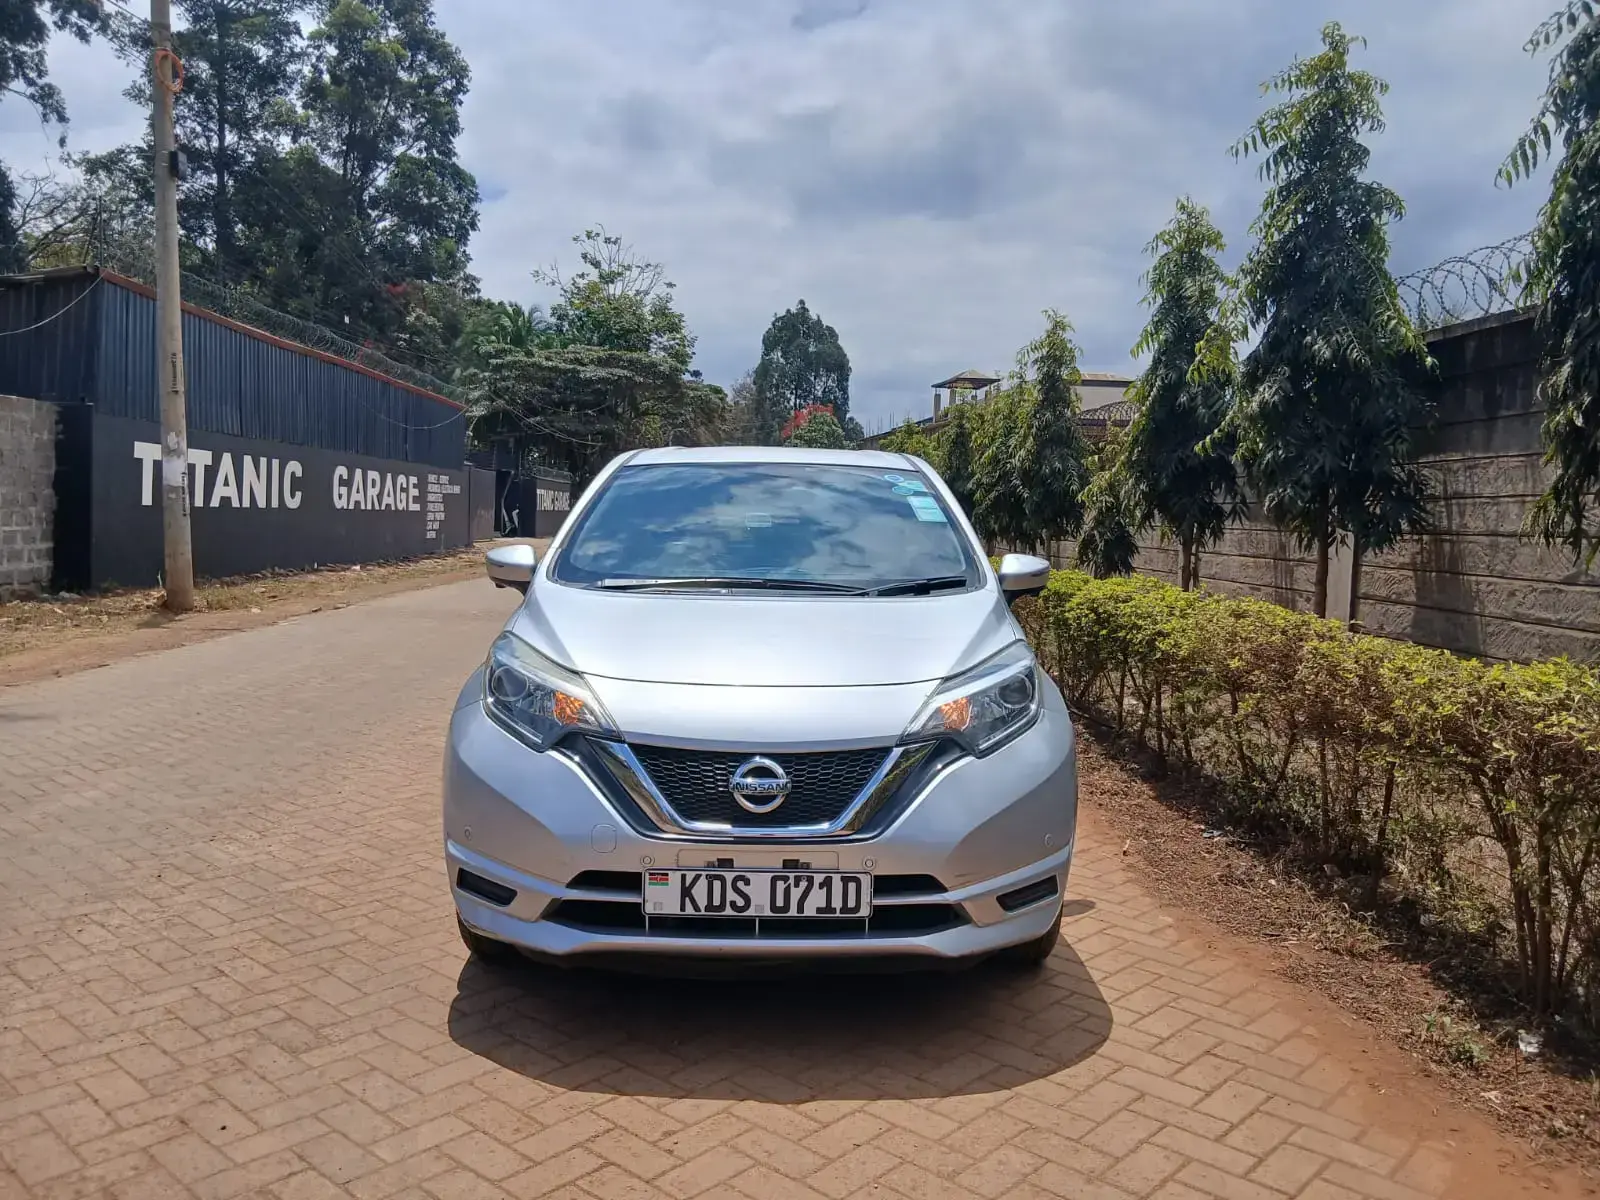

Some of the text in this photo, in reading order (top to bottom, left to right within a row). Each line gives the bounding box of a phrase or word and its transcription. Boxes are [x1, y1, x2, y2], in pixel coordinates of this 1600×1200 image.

[133, 441, 303, 509] TTANIC
[333, 465, 420, 511] GARAGE
[735, 781, 785, 792] NISSAN
[679, 873, 862, 914] KDS 071D
